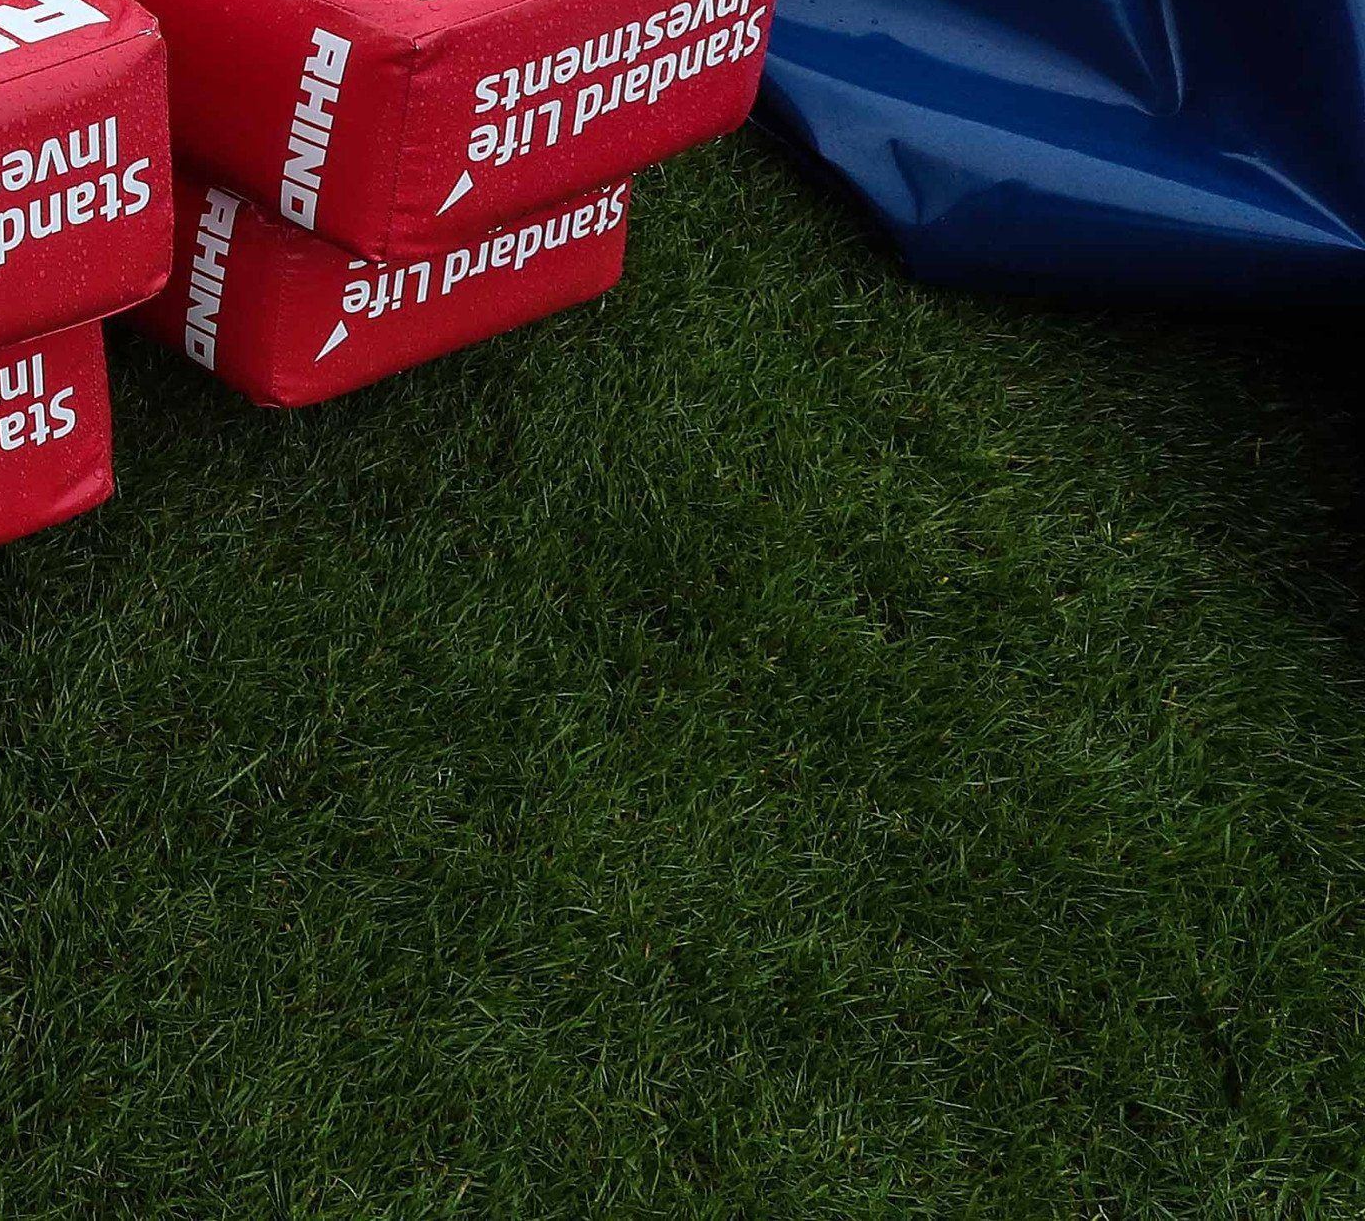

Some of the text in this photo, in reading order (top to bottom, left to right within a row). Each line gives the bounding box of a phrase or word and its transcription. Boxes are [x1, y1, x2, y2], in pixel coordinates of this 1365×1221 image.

[279, 26, 352, 232] RHINO
[467, 5, 767, 167] Standard Life
[184, 187, 241, 372] RHINO
[341, 182, 626, 319] Standard Life
